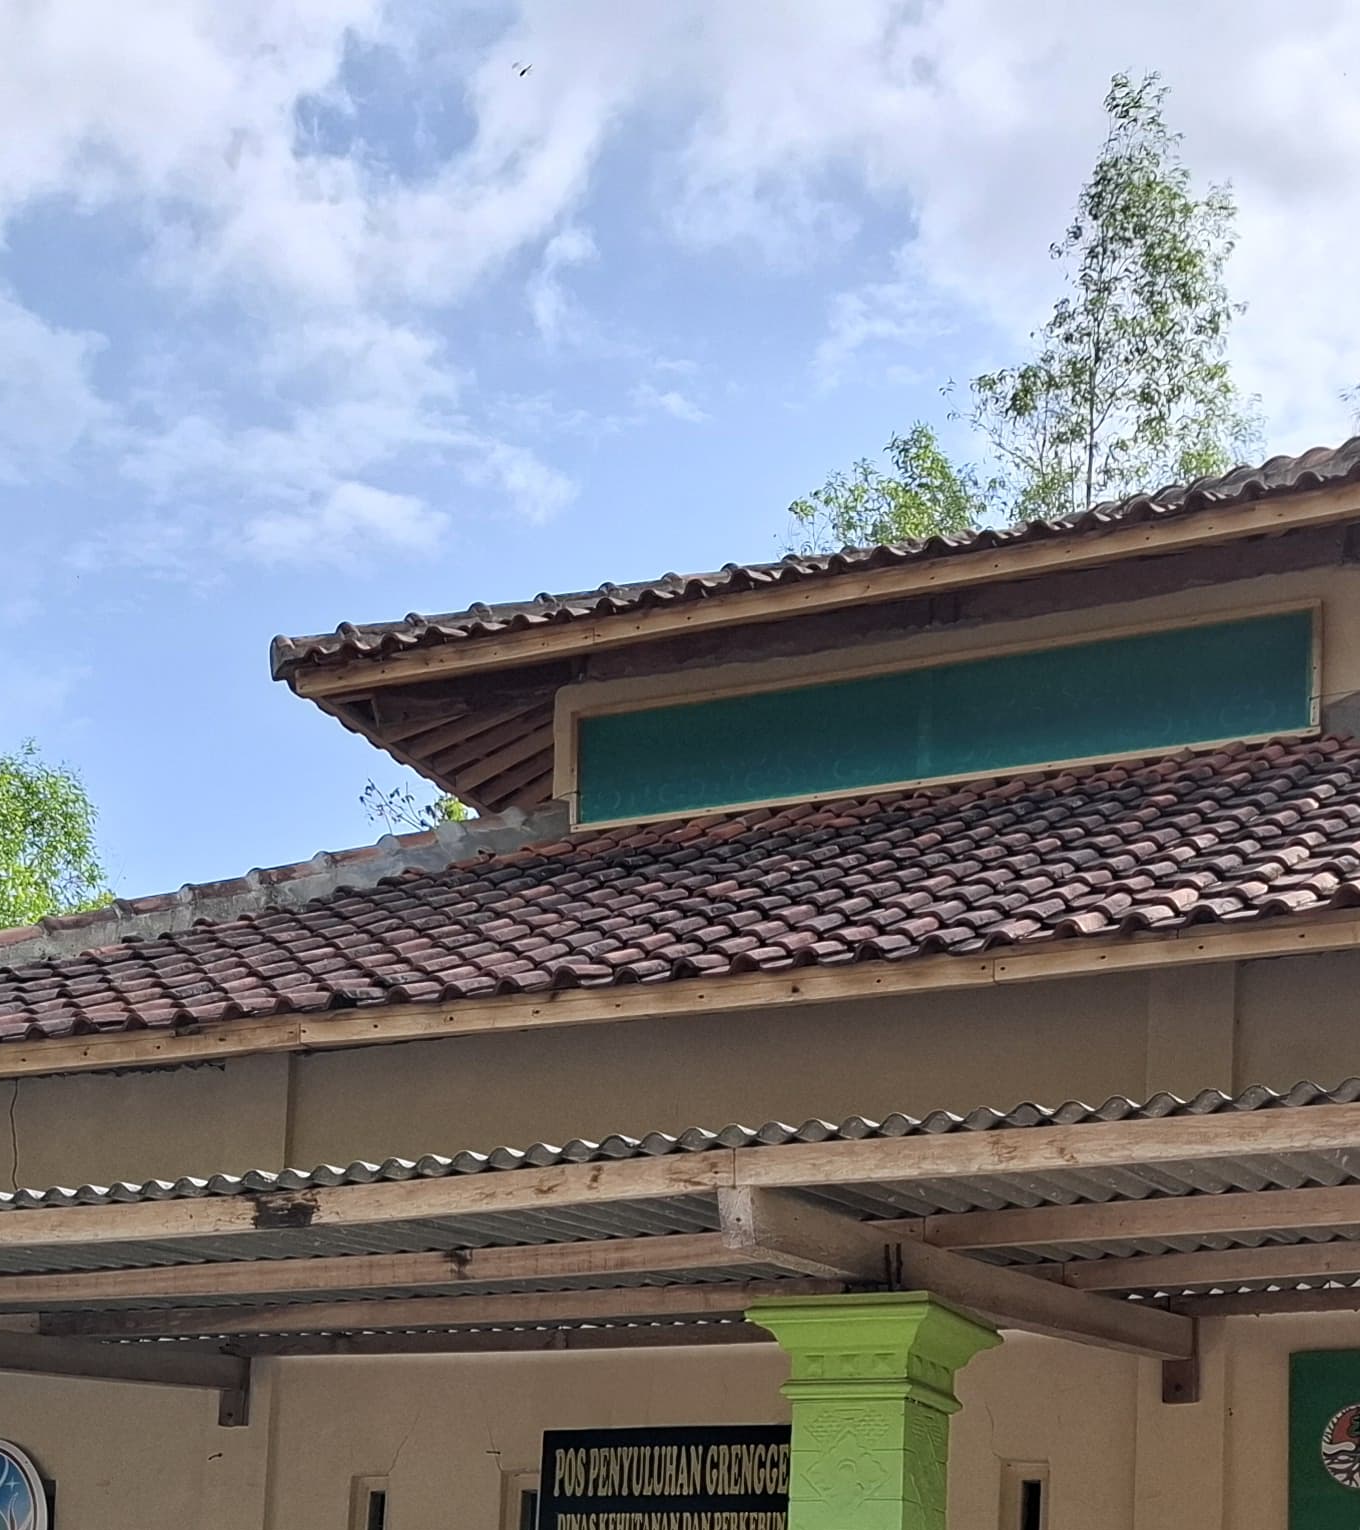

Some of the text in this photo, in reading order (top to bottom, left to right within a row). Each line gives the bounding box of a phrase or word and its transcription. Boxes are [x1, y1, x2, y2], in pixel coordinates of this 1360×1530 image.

[554, 1443, 789, 1497] POS PENYULUHAN GRENGGE
